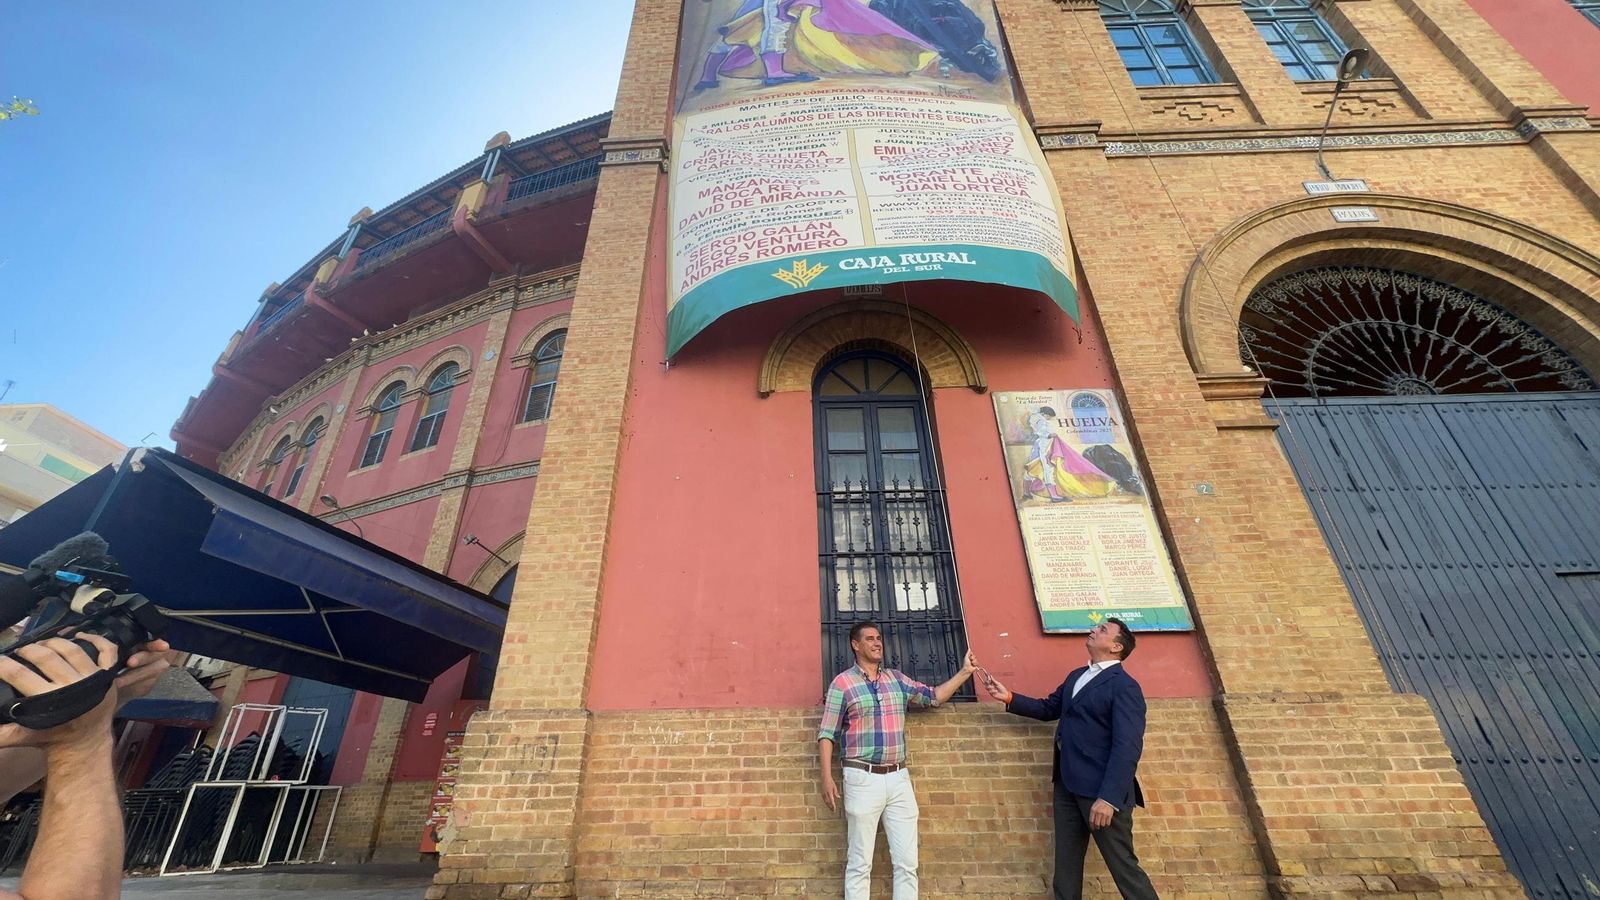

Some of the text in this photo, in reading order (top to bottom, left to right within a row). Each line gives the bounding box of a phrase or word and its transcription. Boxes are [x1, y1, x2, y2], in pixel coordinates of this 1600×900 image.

[739, 100, 788, 112] MARTES
[711, 115, 766, 128] MILLARES
[790, 106, 858, 116] MARCELINO
[726, 122, 750, 132] LOS
[753, 114, 814, 128] ALUMNOS
[818, 112, 835, 120] DE
[839, 110, 863, 119] LAS
[867, 110, 943, 120] DIFERENTES
[805, 130, 841, 138] JULIO
[699, 148, 828, 159] JAVIER ZULUETA
[780, 143, 827, 152] PEREDA
[873, 146, 928, 155] EMILIO
[878, 167, 984, 182] MORANTE
[891, 175, 1029, 190] DANIEL LUQUE
[698, 178, 820, 199] MANZANARES
[712, 183, 804, 203] ROCA REY
[895, 183, 1032, 199] JUAN ORTEGA
[679, 190, 848, 230] DAVID DE MIRANDA
[682, 211, 744, 239] DOMINGO
[784, 199, 848, 210] AGOSTO
[694, 217, 741, 236] Corrida
[766, 206, 823, 217] Rejones
[690, 231, 756, 262] SERGIO
[762, 221, 833, 236] GALÁN
[756, 238, 848, 258] ROMERO
[686, 245, 738, 277] DIEGO
[744, 229, 841, 250] VENTURA
[838, 255, 896, 270] CAJA
[898, 252, 977, 265] RURAL
[883, 264, 944, 274] DEL SUR
[1058, 416, 1118, 428] HUELVA
[1200, 484, 1208, 494] 2
